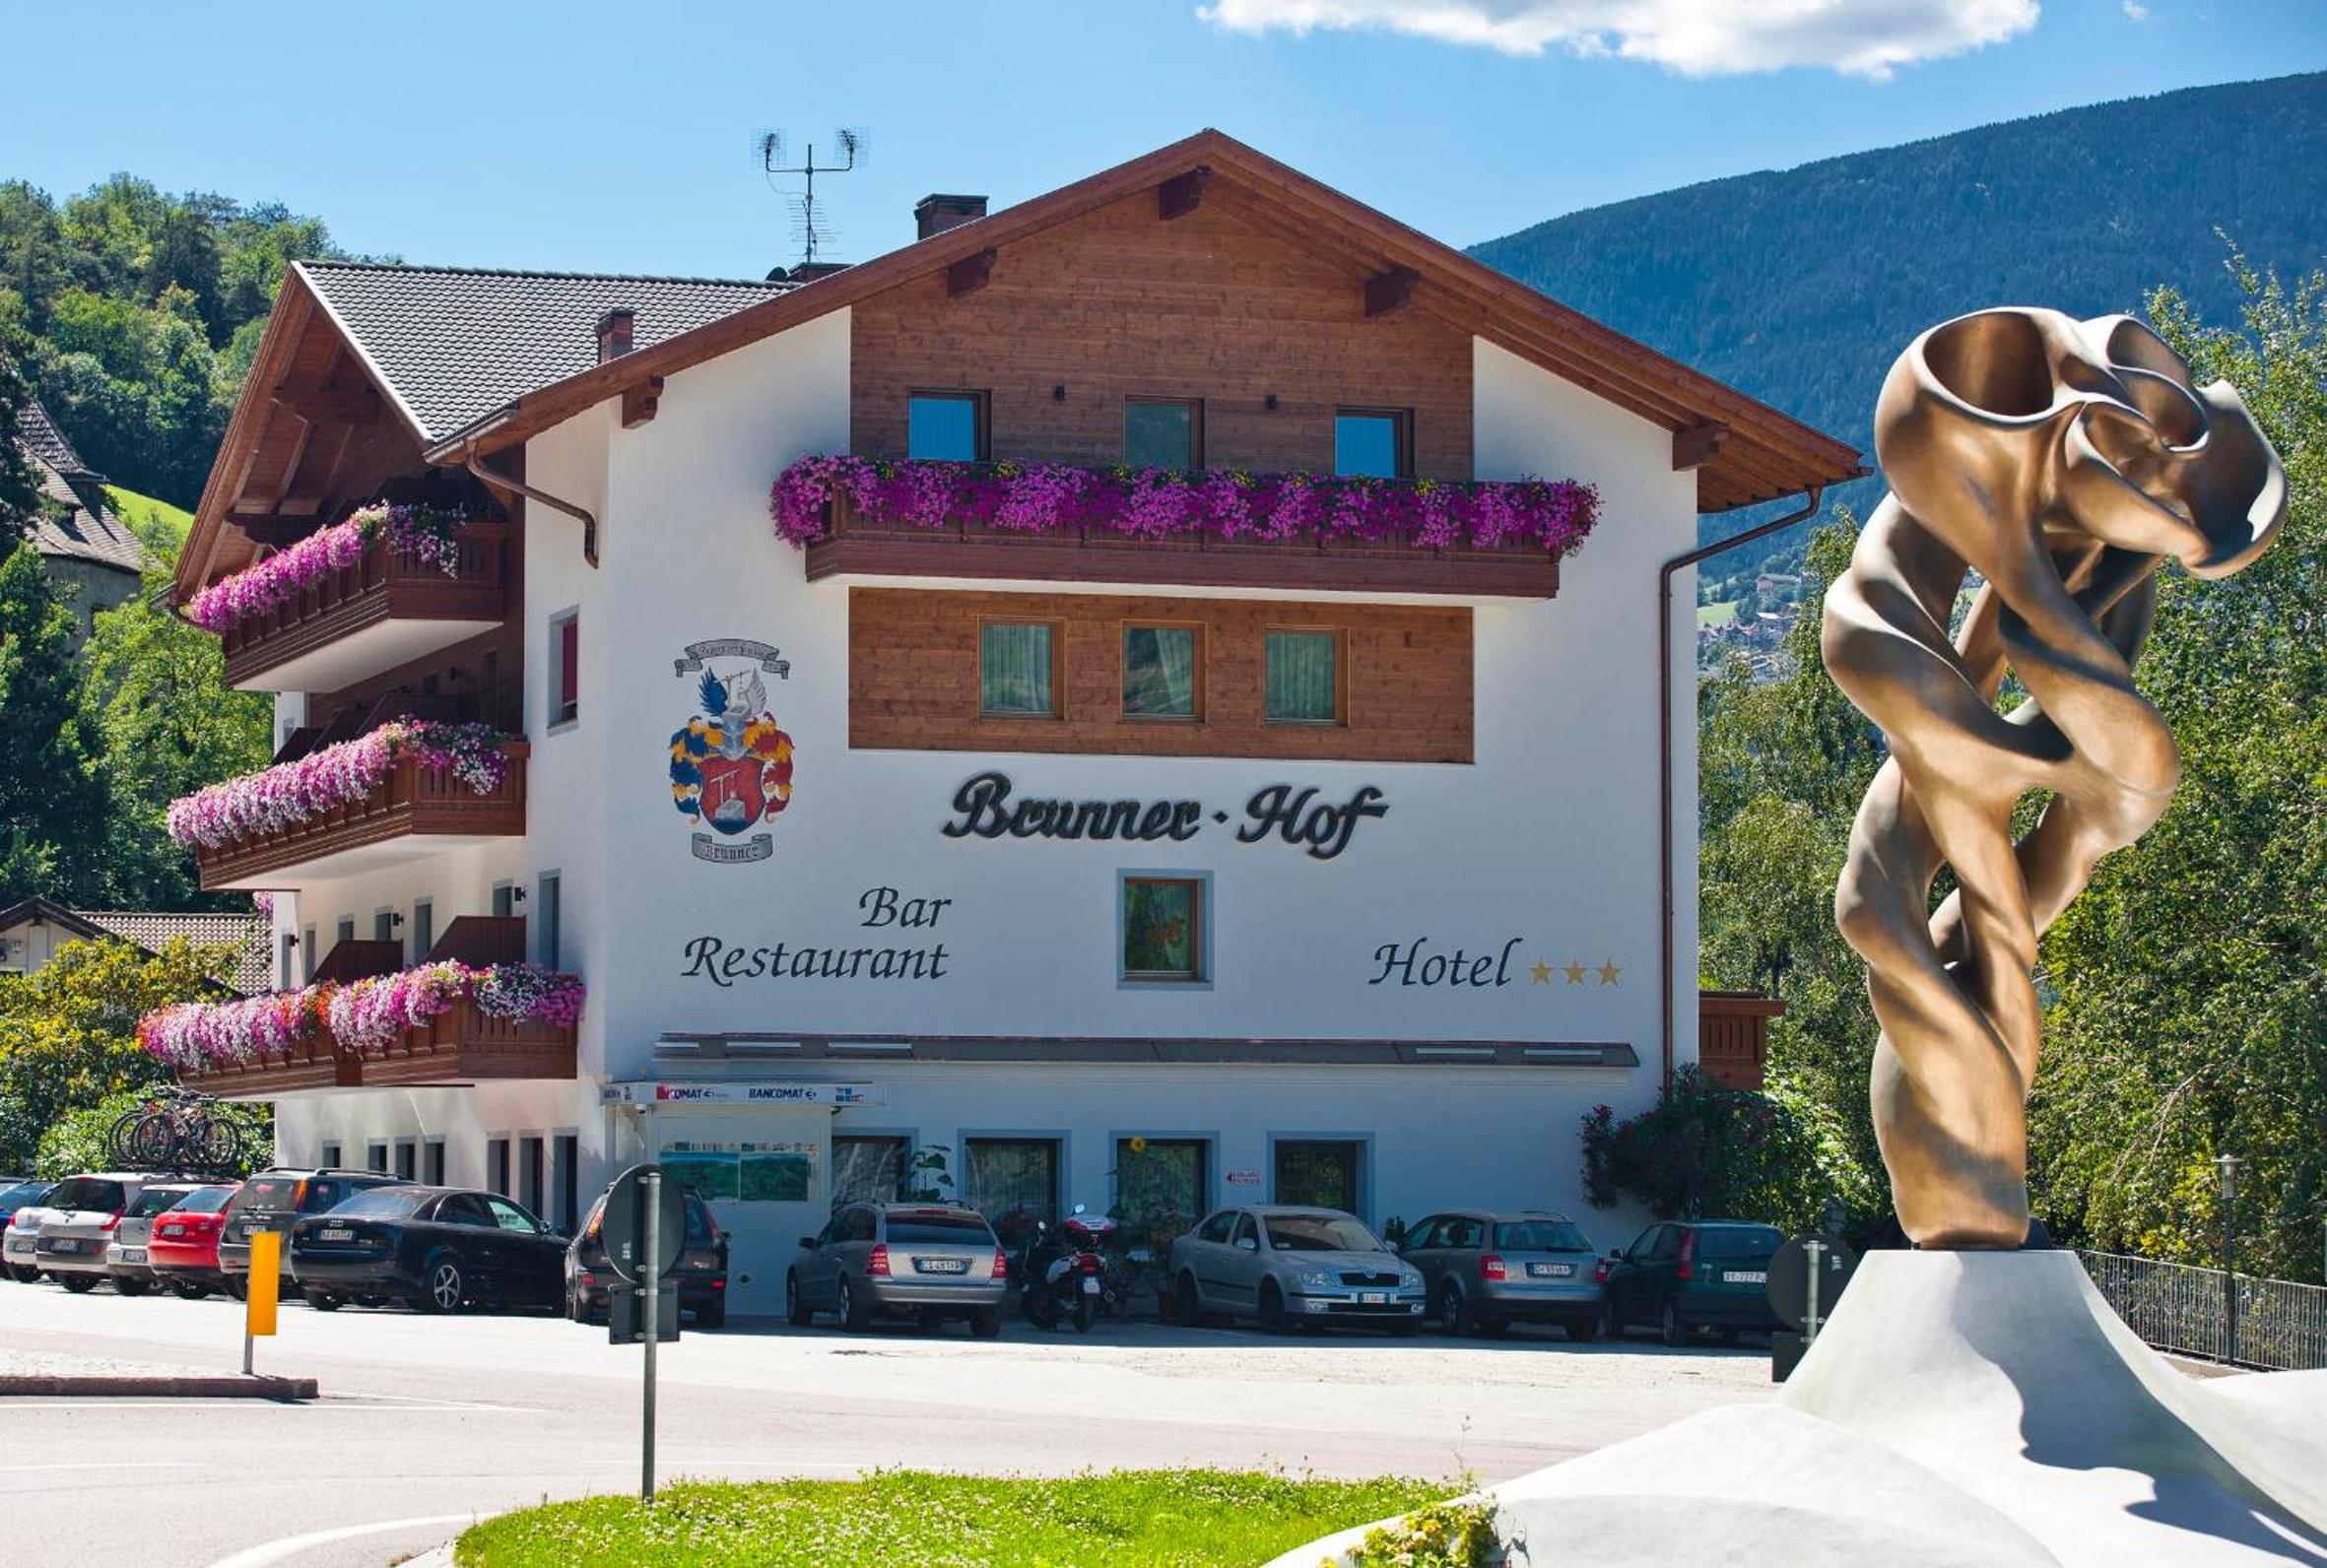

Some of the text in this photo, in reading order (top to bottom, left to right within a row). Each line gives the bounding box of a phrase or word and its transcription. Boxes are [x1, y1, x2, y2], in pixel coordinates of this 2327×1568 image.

[941, 772, 1201, 841] Brunner
[1236, 785, 1390, 860] Hof
[859, 886, 953, 928] Bar
[681, 937, 949, 987] Restaurant
[1368, 937, 1523, 987] Hotel
[749, 1087, 803, 1099] BANCOMAT
